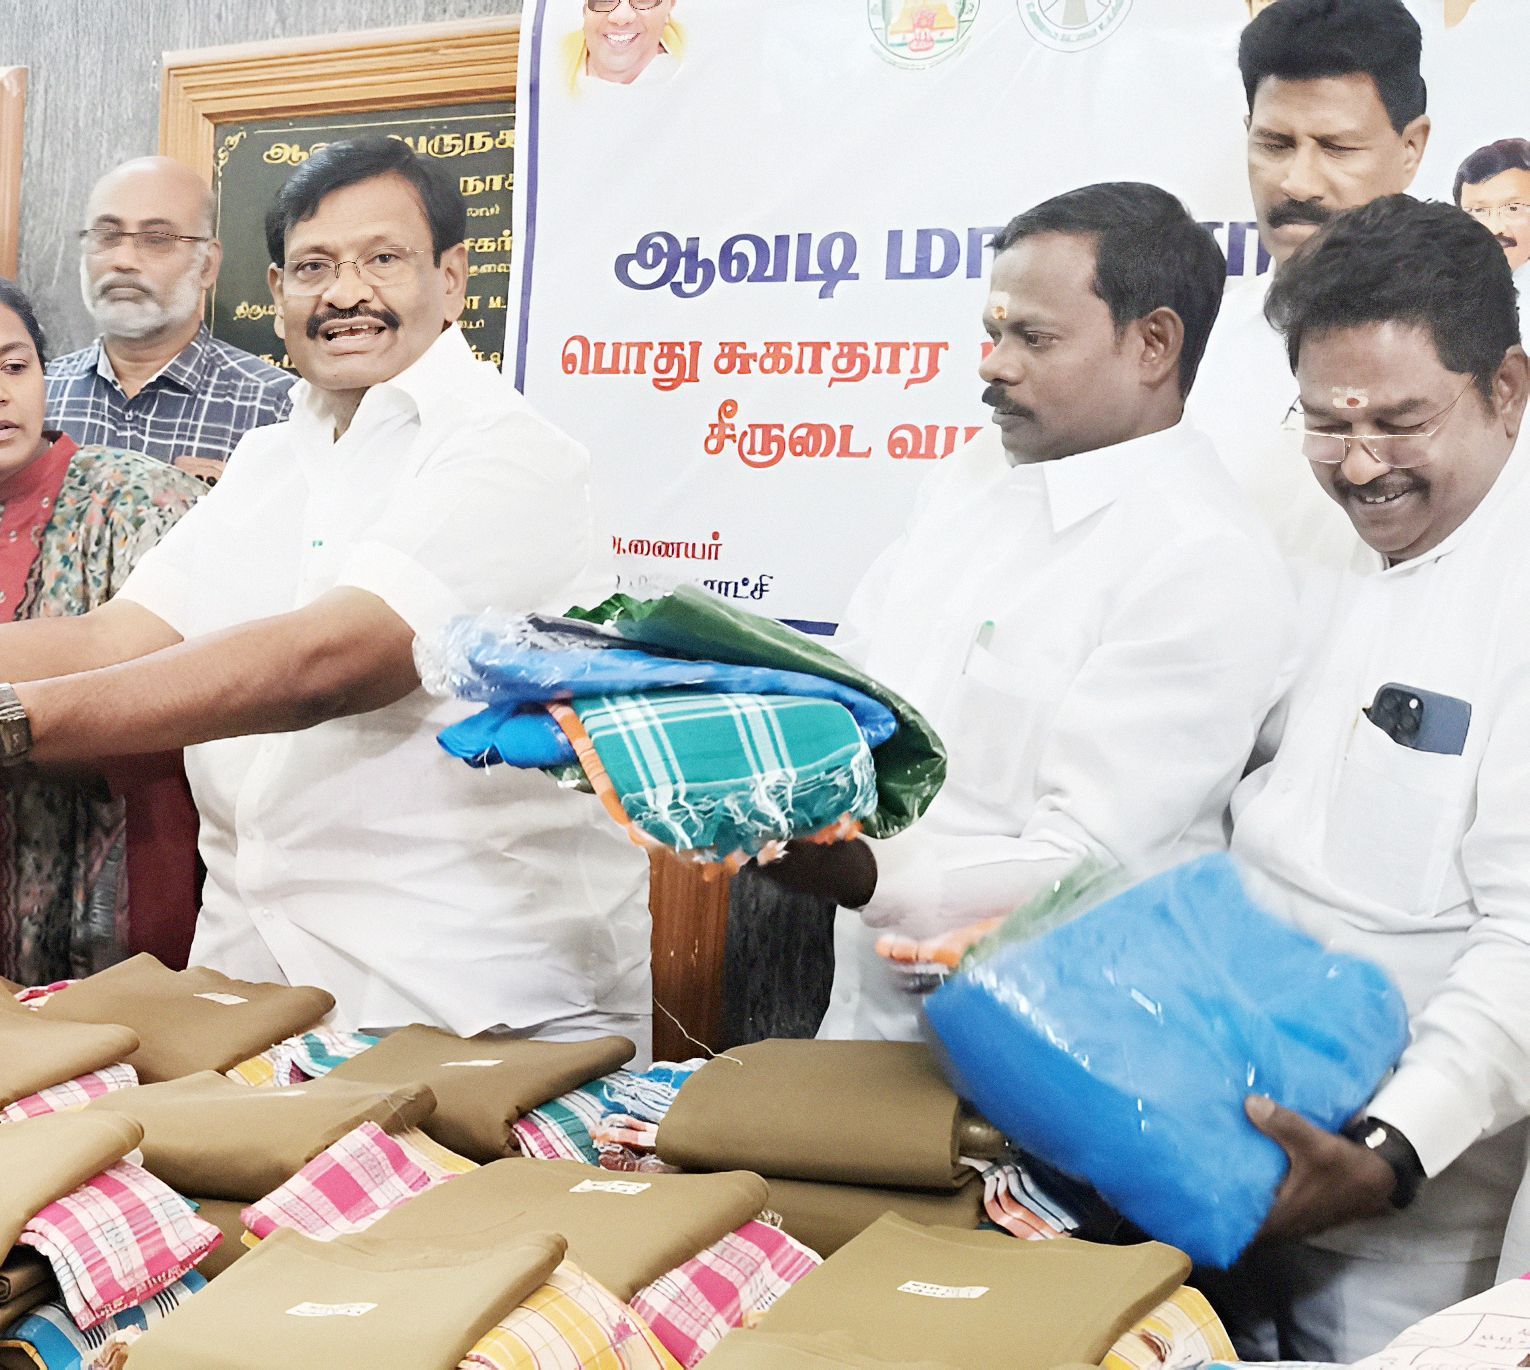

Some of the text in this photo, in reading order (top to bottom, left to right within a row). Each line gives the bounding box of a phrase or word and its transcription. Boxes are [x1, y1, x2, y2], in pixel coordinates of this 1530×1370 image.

[614, 231, 859, 299] ஆவடி
[561, 335, 949, 392] பொது சுகாதார
[704, 398, 872, 469] சீருடை
